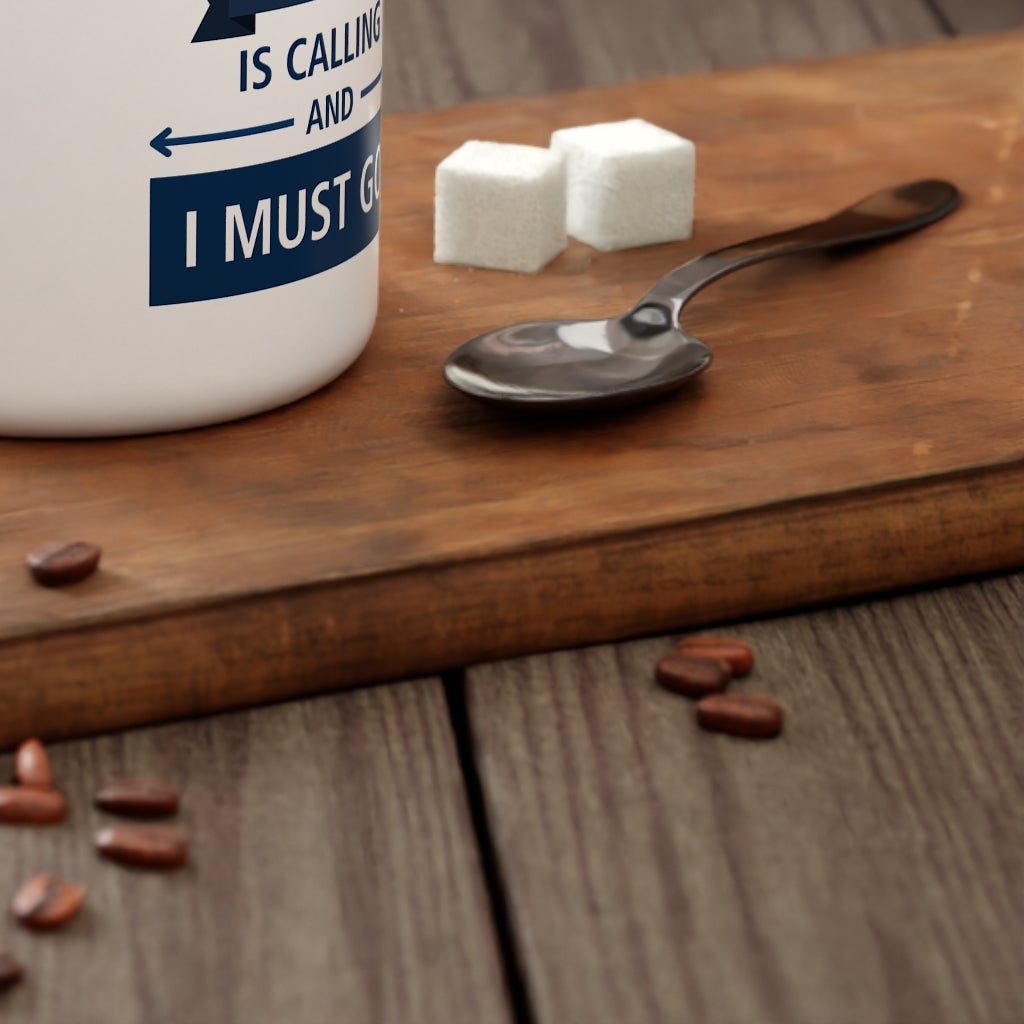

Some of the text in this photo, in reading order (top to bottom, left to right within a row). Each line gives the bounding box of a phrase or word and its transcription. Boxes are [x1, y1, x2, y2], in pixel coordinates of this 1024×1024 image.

[239, 0, 380, 92] IS CALLING
[305, 86, 354, 135] AND
[185, 210, 197, 268] I
[224, 170, 351, 263] MUST
